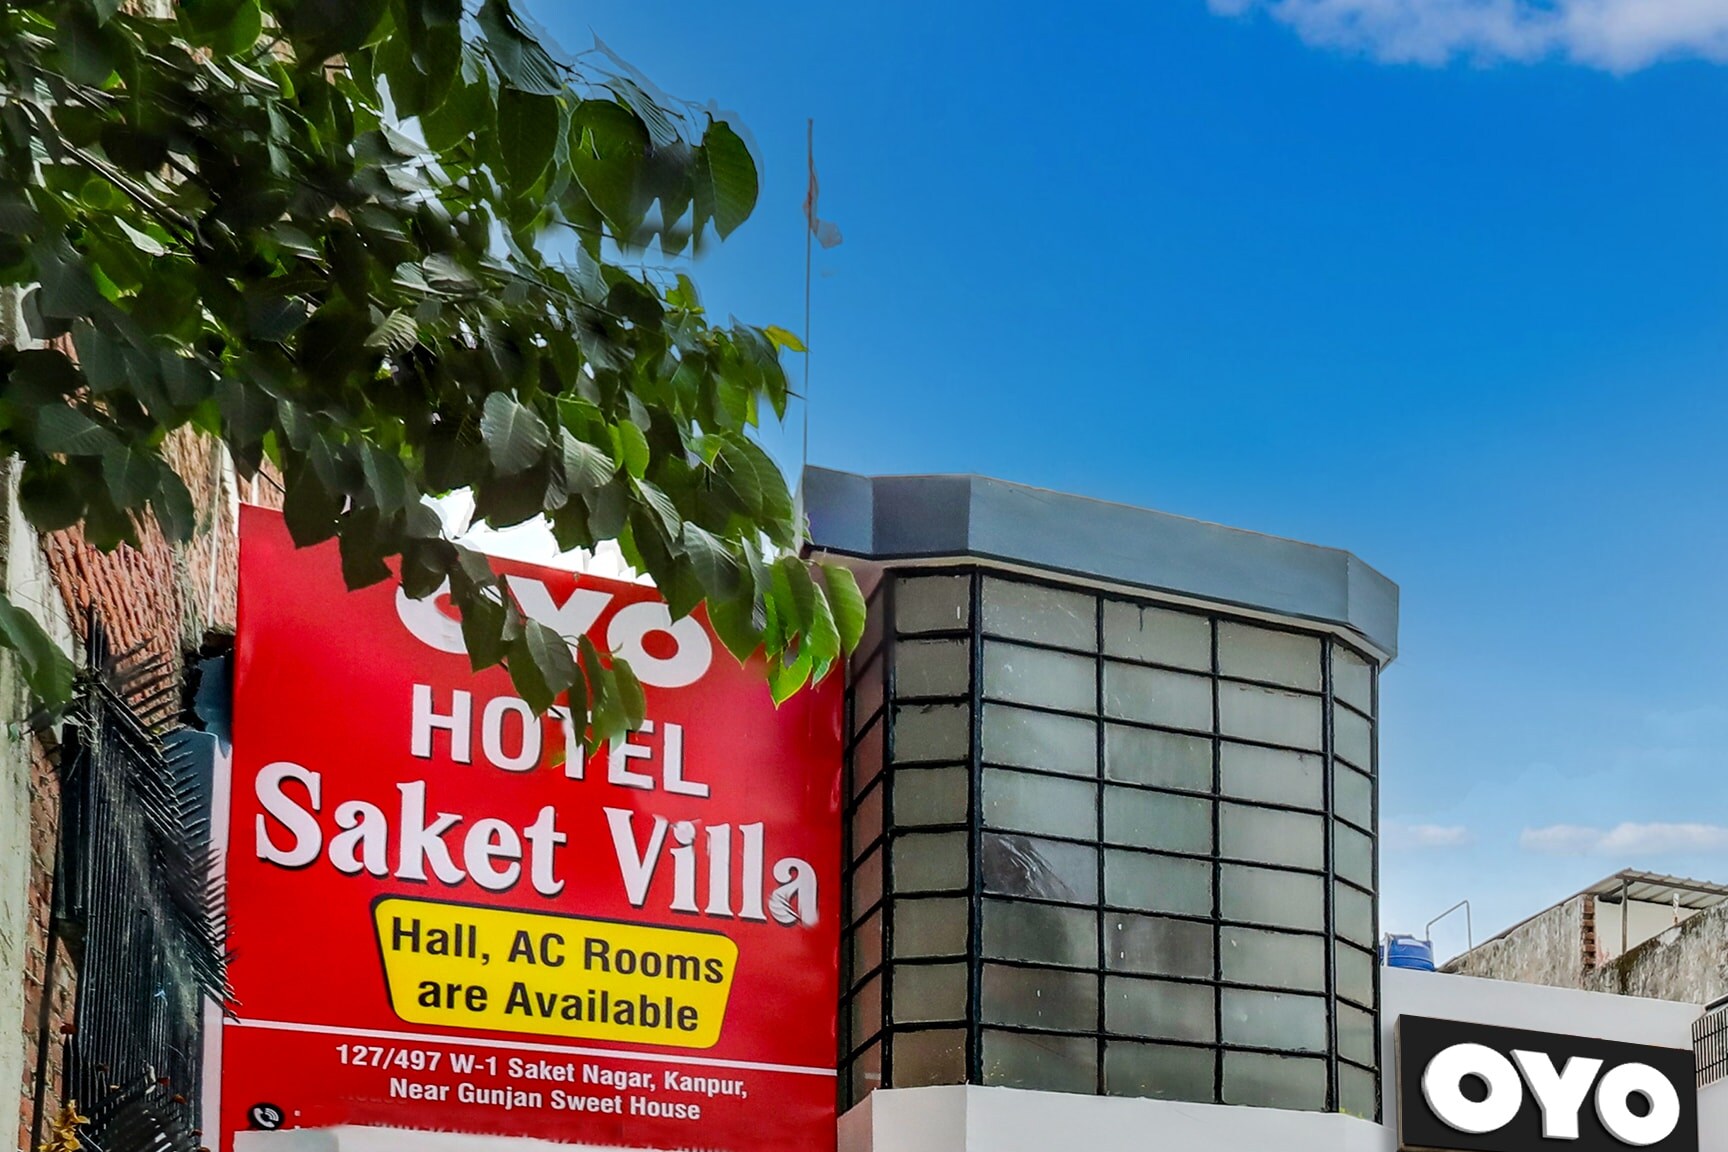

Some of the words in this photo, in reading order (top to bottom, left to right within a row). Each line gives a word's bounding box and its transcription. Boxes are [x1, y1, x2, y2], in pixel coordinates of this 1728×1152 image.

[411, 684, 710, 797] HOTEL
[254, 762, 566, 896] Saket
[603, 806, 819, 926] Villa
[392, 917, 490, 966] Hall,
[507, 929, 566, 968] AC
[583, 939, 724, 985] Rooms
[417, 979, 487, 1013] are
[504, 982, 700, 1032] Available
[336, 1044, 440, 1073] 127/497
[449, 1052, 498, 1077] W-1
[508, 1057, 575, 1083] Saket
[582, 1064, 656, 1093] Nagar,
[663, 1072, 747, 1099] Kanpur,
[389, 1076, 449, 1103] Near
[457, 1080, 543, 1112] Gunjan
[550, 1089, 622, 1116] Sweet
[629, 1097, 701, 1121] House
[1421, 1042, 1680, 1146] OYO
